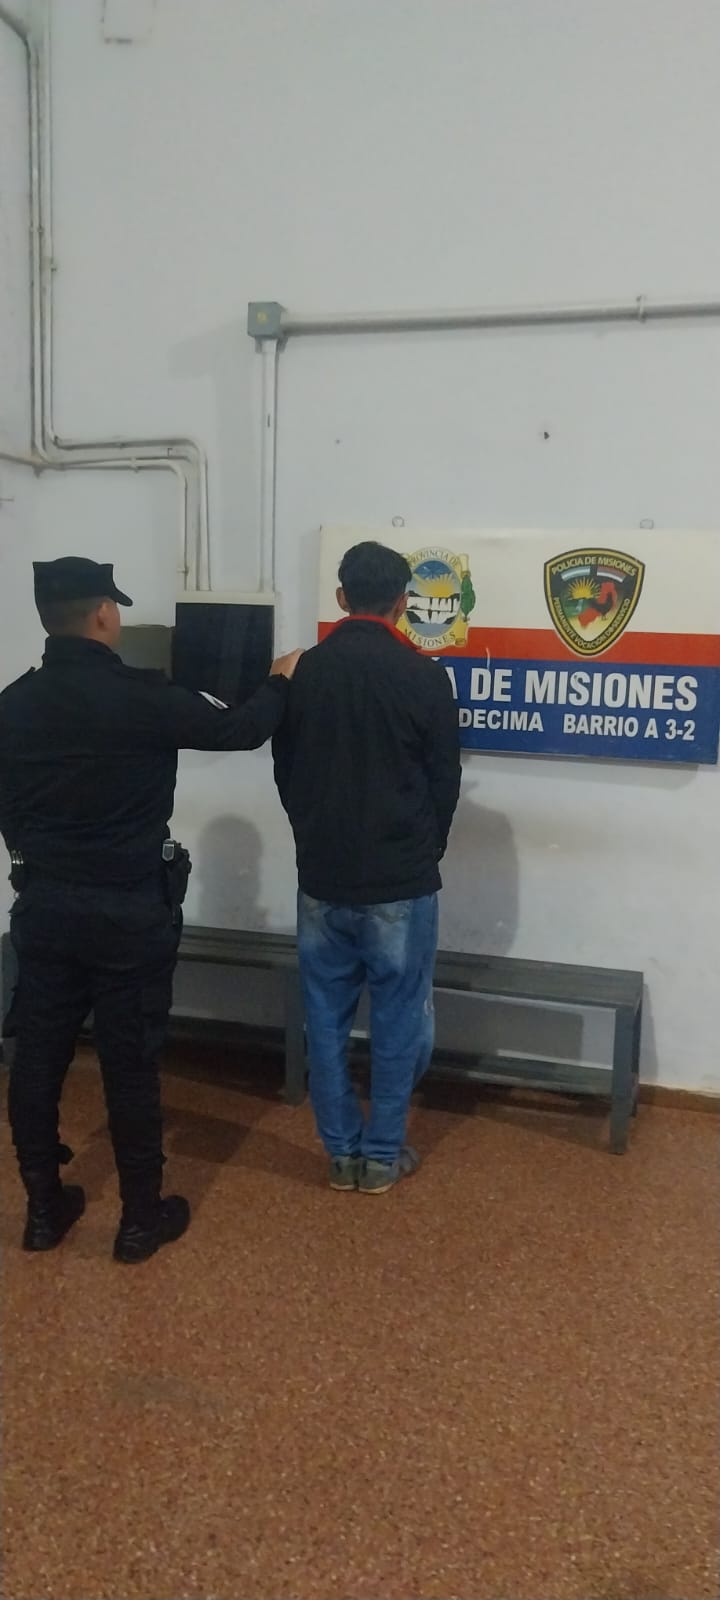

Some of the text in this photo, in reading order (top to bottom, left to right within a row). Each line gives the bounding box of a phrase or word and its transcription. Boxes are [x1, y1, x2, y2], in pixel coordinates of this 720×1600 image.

[551, 556, 638, 577] POLICIA DE MISIONES
[470, 667, 512, 702] DE
[524, 669, 699, 712] MISIONES
[458, 707, 696, 741] DECIMA BARRIO A 3-2
